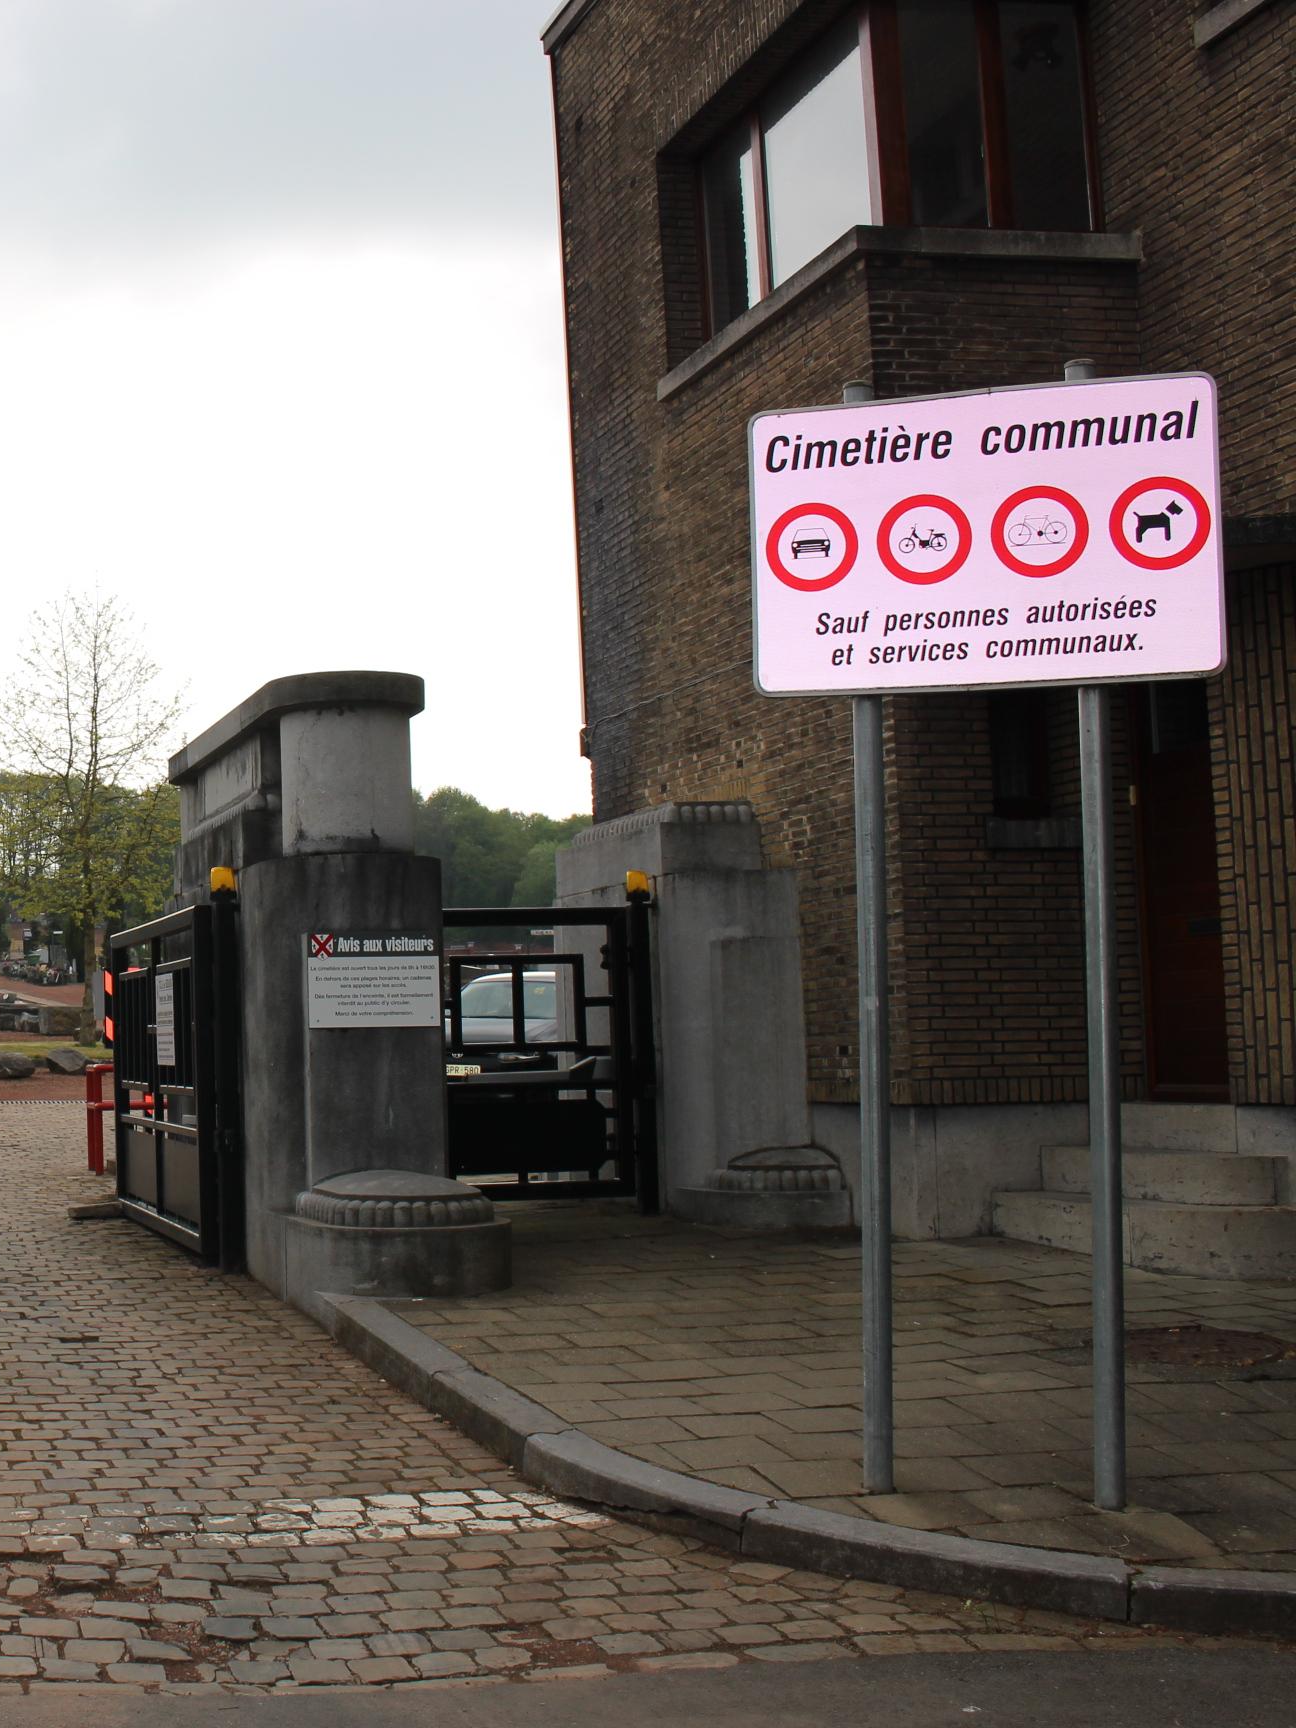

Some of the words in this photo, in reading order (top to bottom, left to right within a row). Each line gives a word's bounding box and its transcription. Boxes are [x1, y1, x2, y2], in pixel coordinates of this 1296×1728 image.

[765, 424, 953, 474] Cimetière
[980, 399, 1200, 457] communal
[815, 610, 870, 636] Sauf
[883, 606, 1010, 637] personnes
[1025, 594, 1157, 625] autorisées
[831, 643, 854, 667] et
[868, 639, 970, 665] services
[985, 632, 1145, 660] communaux.
[337, 937, 360, 952] Avis
[363, 940, 383, 952] aux
[386, 937, 434, 952] visiteurs
